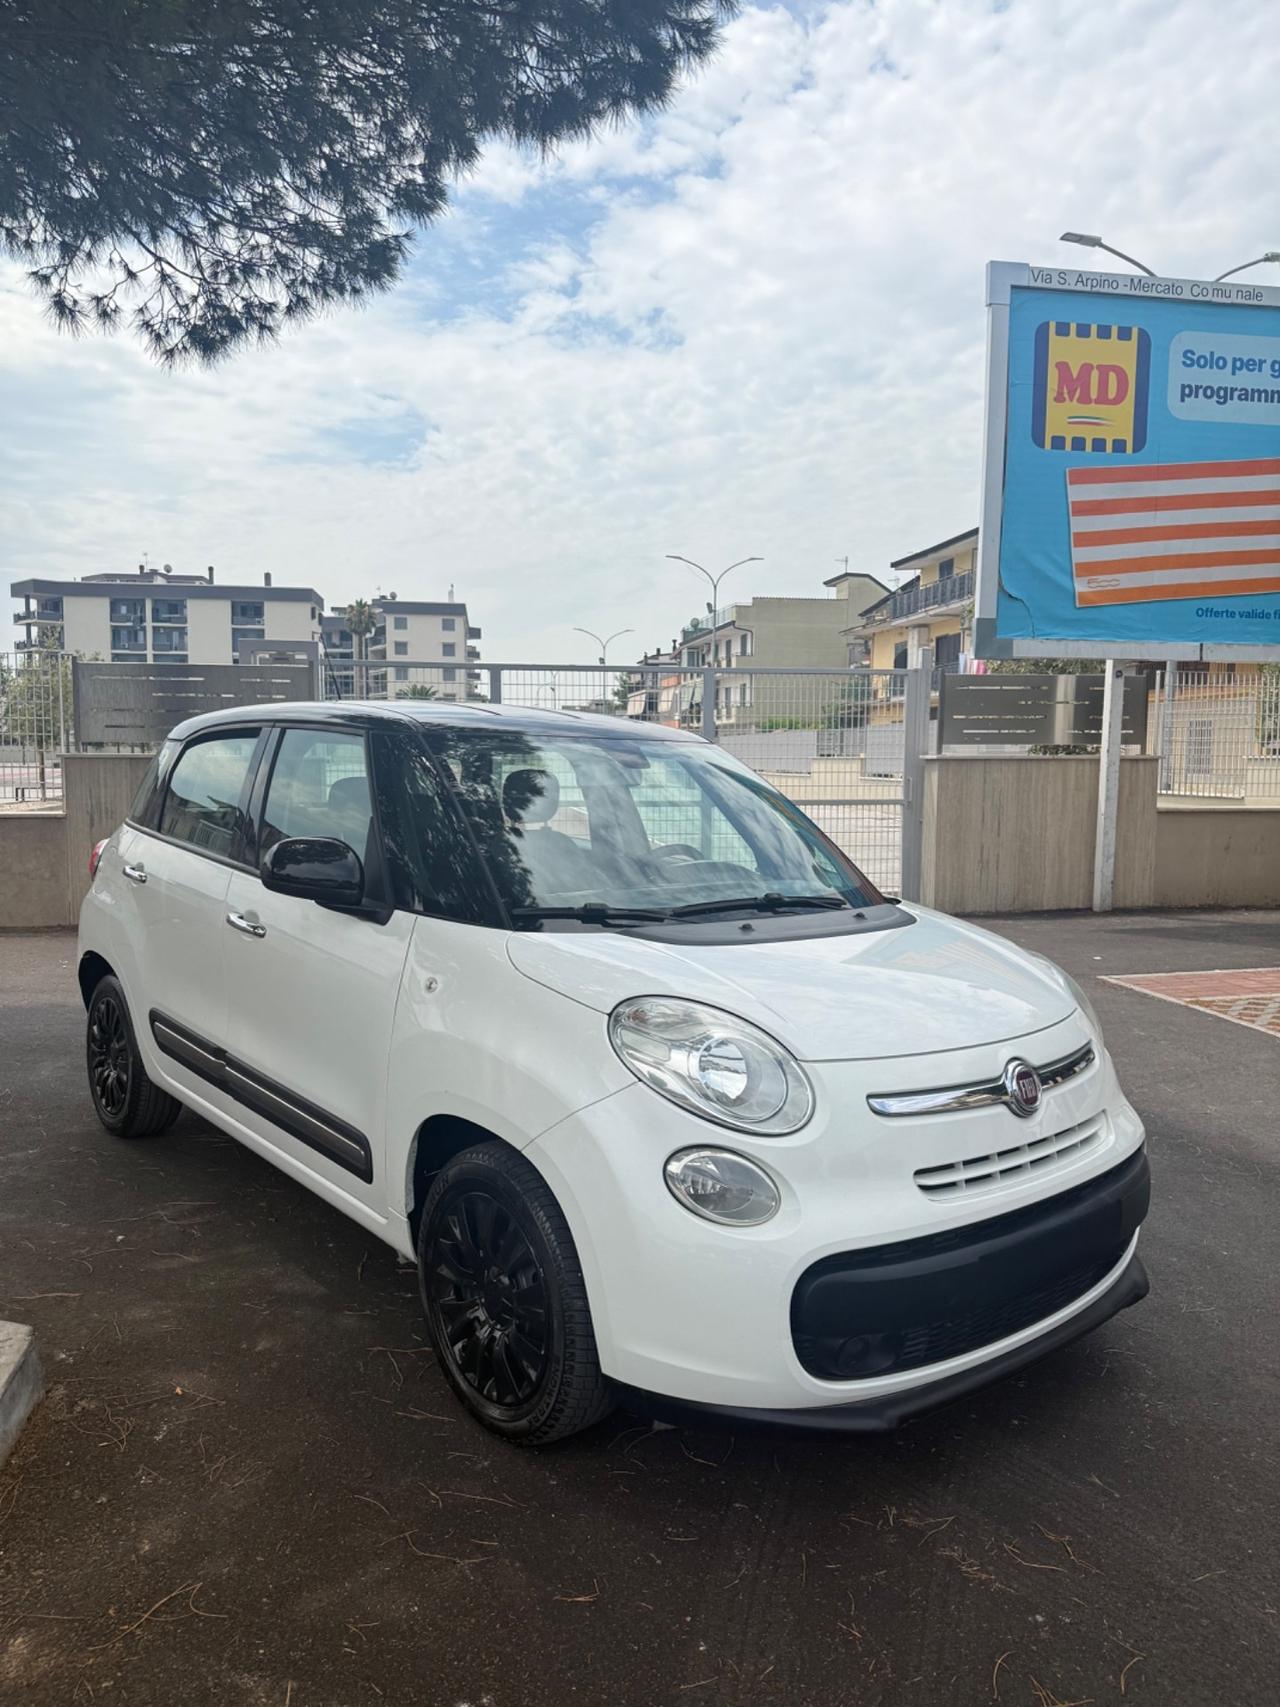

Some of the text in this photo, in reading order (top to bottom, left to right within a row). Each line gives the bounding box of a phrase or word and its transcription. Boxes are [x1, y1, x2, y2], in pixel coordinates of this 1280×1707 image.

[1031, 269, 1053, 284] Via
[1057, 271, 1071, 286] S.
[1074, 273, 1120, 292] Arpino
[1182, 348, 1228, 370] Solo
[1231, 356, 1267, 376] per
[1053, 360, 1130, 406] MD
[1195, 607, 1237, 619] Offerte
[1238, 608, 1272, 620] valide
